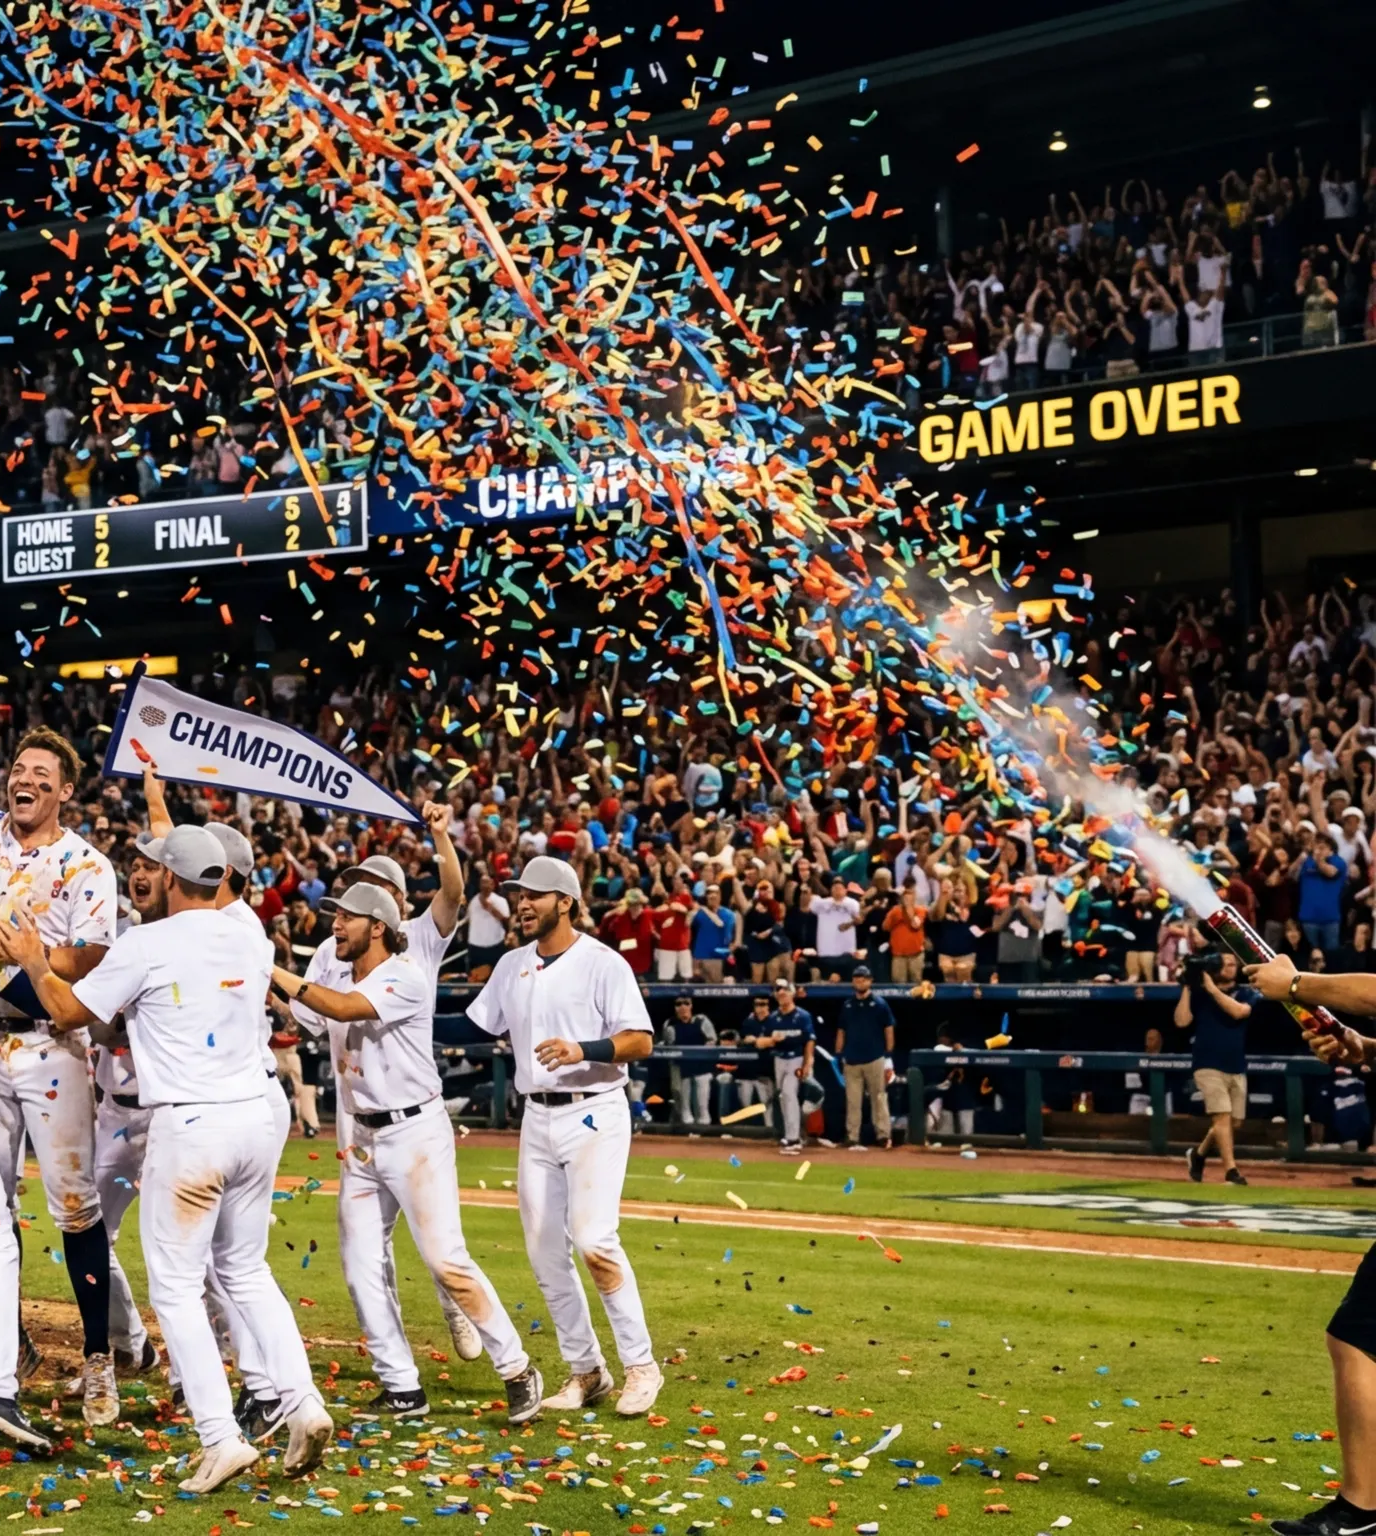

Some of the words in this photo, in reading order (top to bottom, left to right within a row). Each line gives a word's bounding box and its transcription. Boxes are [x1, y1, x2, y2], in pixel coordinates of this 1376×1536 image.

[918, 397, 1075, 463] GAME
[1089, 374, 1241, 441] OVER
[284, 496, 300, 521] 5
[17, 517, 73, 546] HOME
[94, 514, 109, 539] 5
[154, 514, 230, 550] FINAL
[285, 524, 300, 551] 2
[13, 546, 76, 575] GUEST
[94, 543, 110, 568] 2
[169, 711, 353, 800] CHAMPIONS
